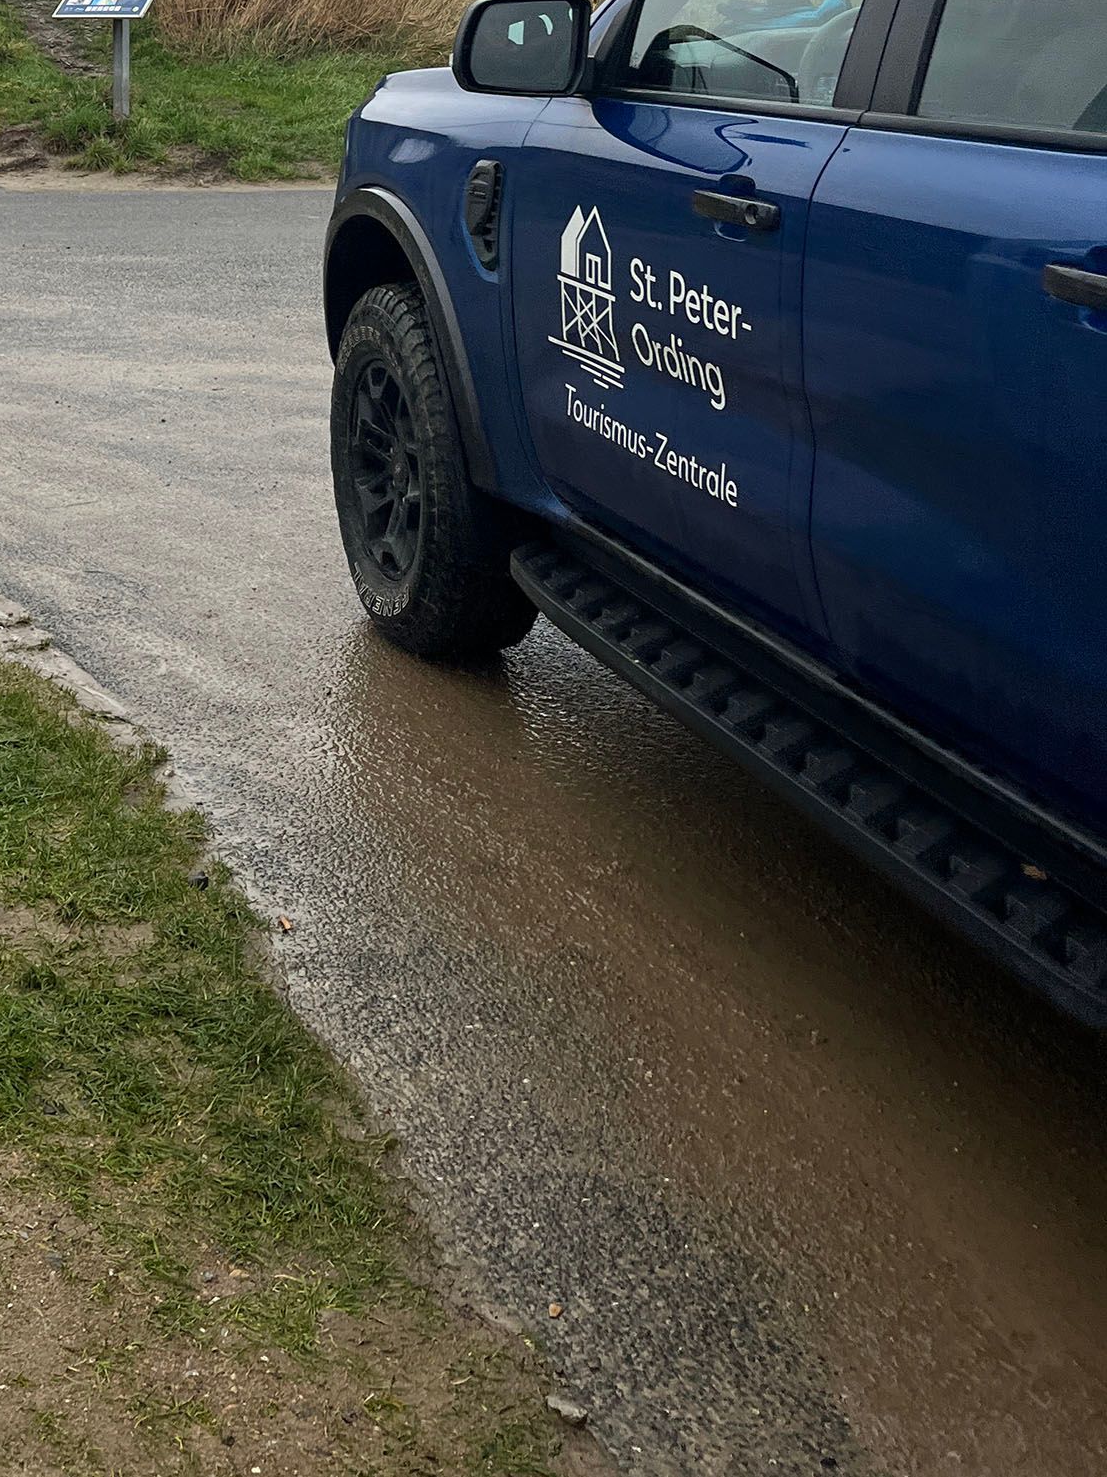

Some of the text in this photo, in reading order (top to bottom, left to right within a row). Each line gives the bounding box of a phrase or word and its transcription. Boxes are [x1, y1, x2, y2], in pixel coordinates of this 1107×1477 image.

[629, 257, 752, 340] St. Peter-
[631, 322, 726, 411] Ording
[565, 383, 738, 507] Tourismus-Zentrale
